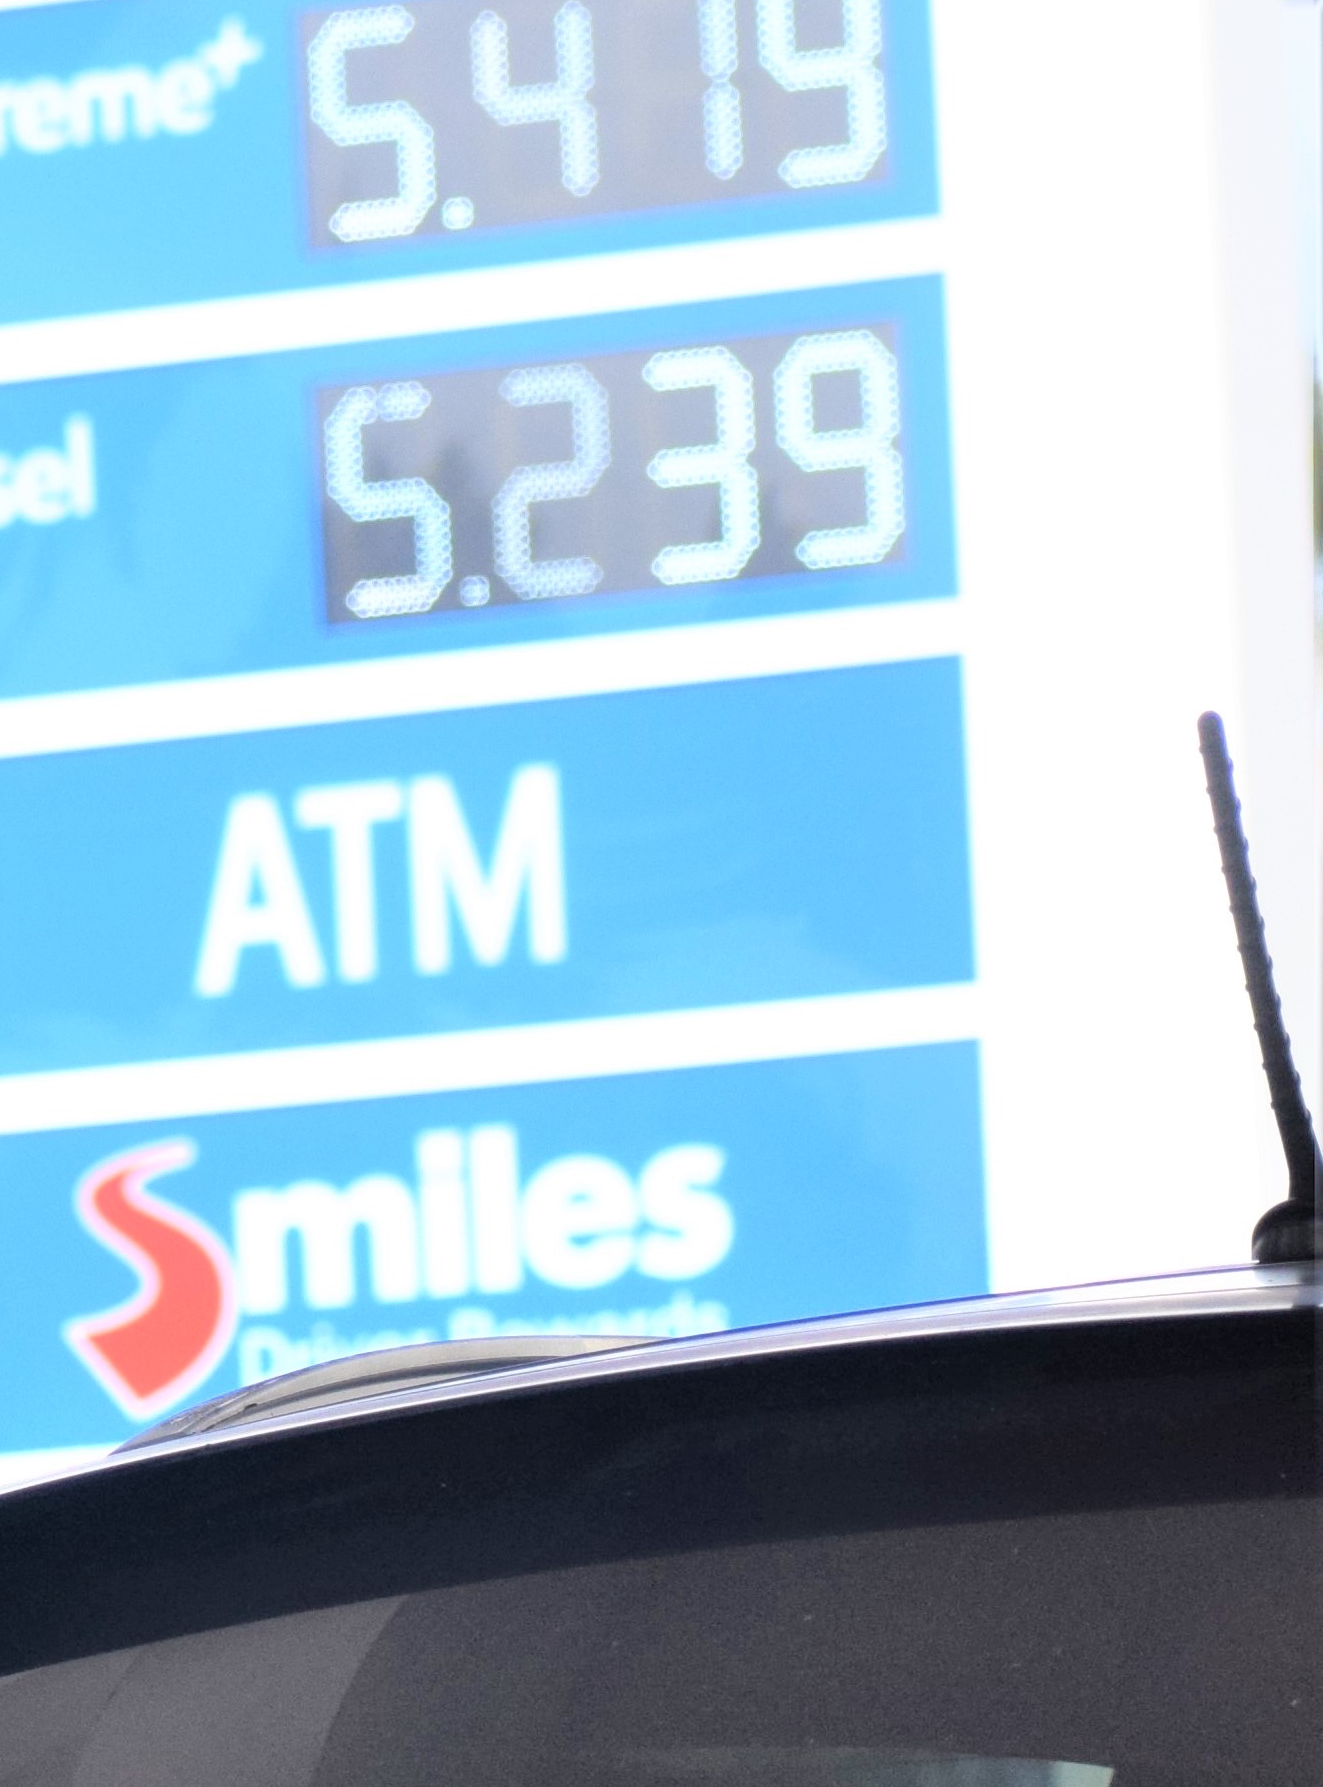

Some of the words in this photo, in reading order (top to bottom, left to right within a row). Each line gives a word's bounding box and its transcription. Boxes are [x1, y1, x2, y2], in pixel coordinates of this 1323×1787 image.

[322, 328, 905, 620] 5.239
[192, 759, 570, 999] ATM
[61, 1120, 736, 1422] Smiles
